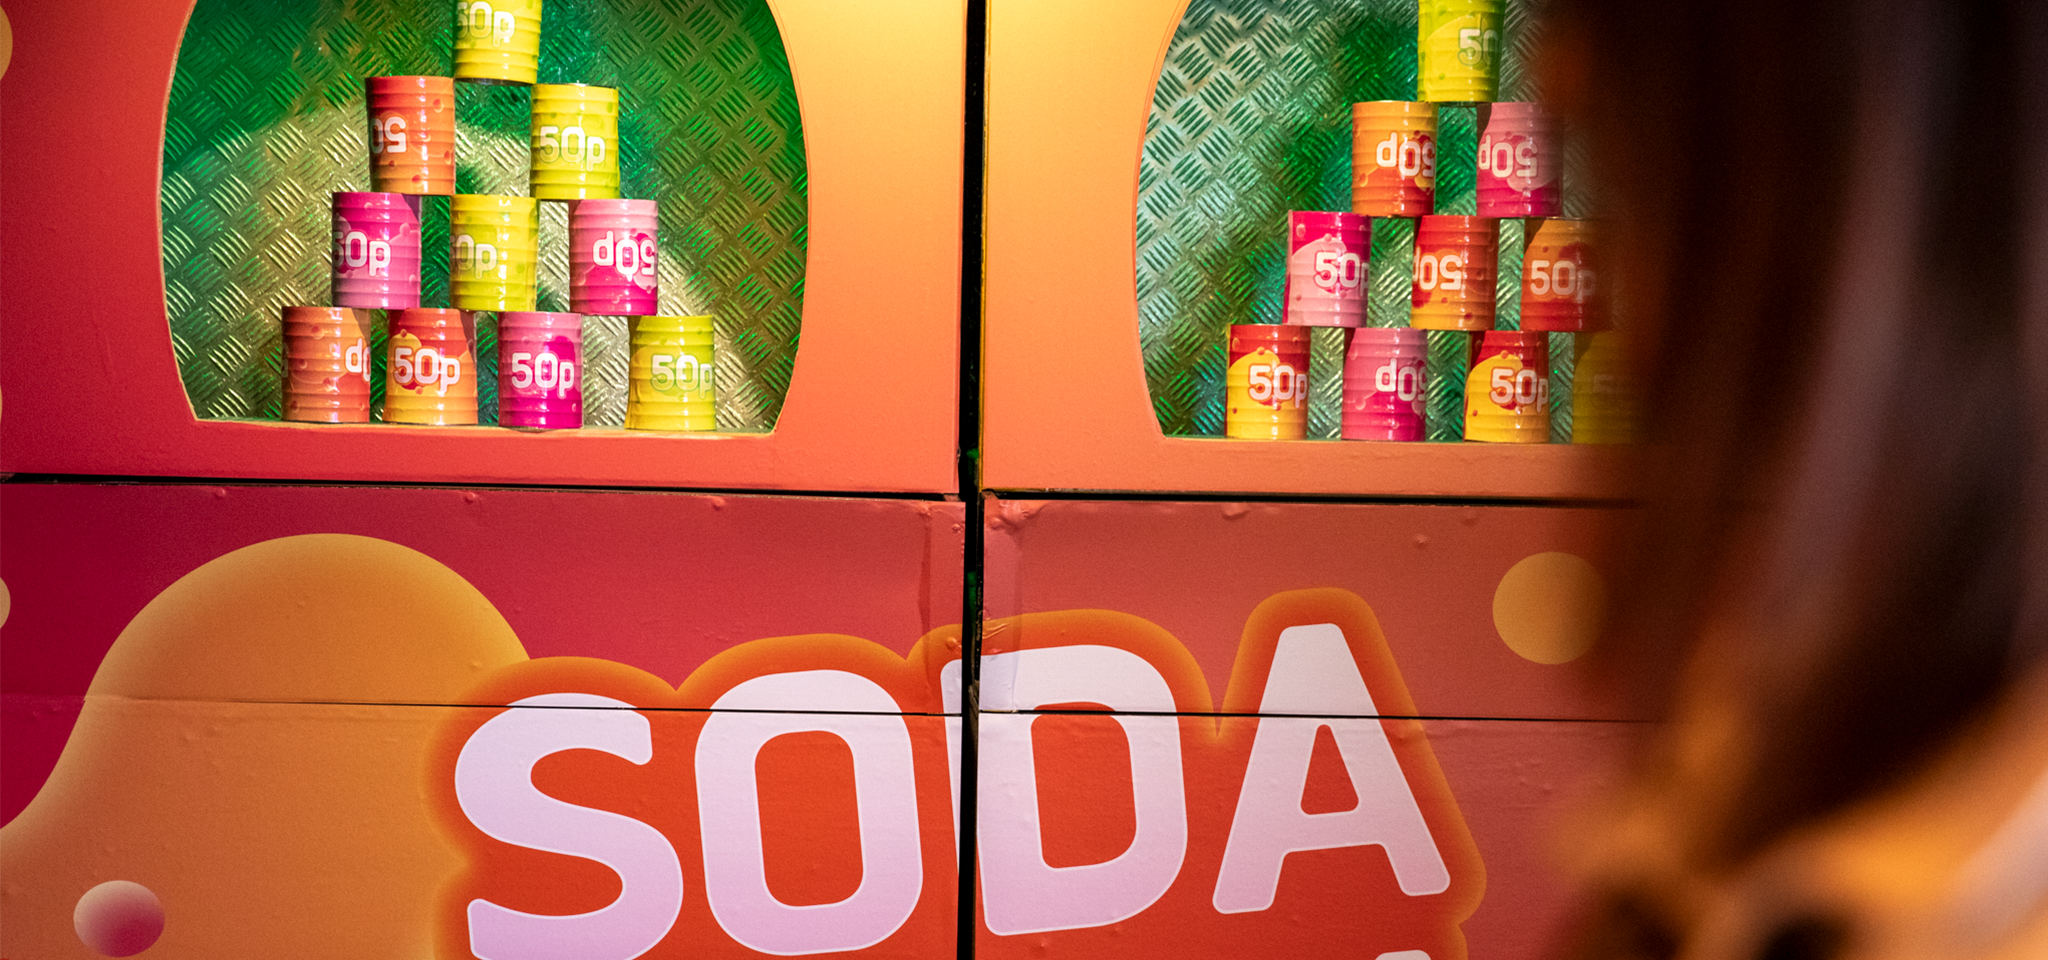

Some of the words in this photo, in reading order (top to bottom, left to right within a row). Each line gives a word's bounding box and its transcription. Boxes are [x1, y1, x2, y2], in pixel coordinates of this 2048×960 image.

[1459, 28, 1499, 65] 50
[370, 115, 407, 154] 50
[539, 126, 606, 172] 50p
[1376, 132, 1436, 177] 50p
[1479, 134, 1538, 178] 50p
[593, 230, 656, 276] 50p
[1314, 251, 1369, 298] 50p
[1530, 260, 1597, 304] 50p
[394, 347, 461, 396] 50p
[511, 352, 575, 399] 50p
[651, 354, 713, 399] 50p
[1249, 364, 1307, 409] 50p
[1490, 368, 1549, 413] 50p
[454, 622, 1451, 960] SODA
